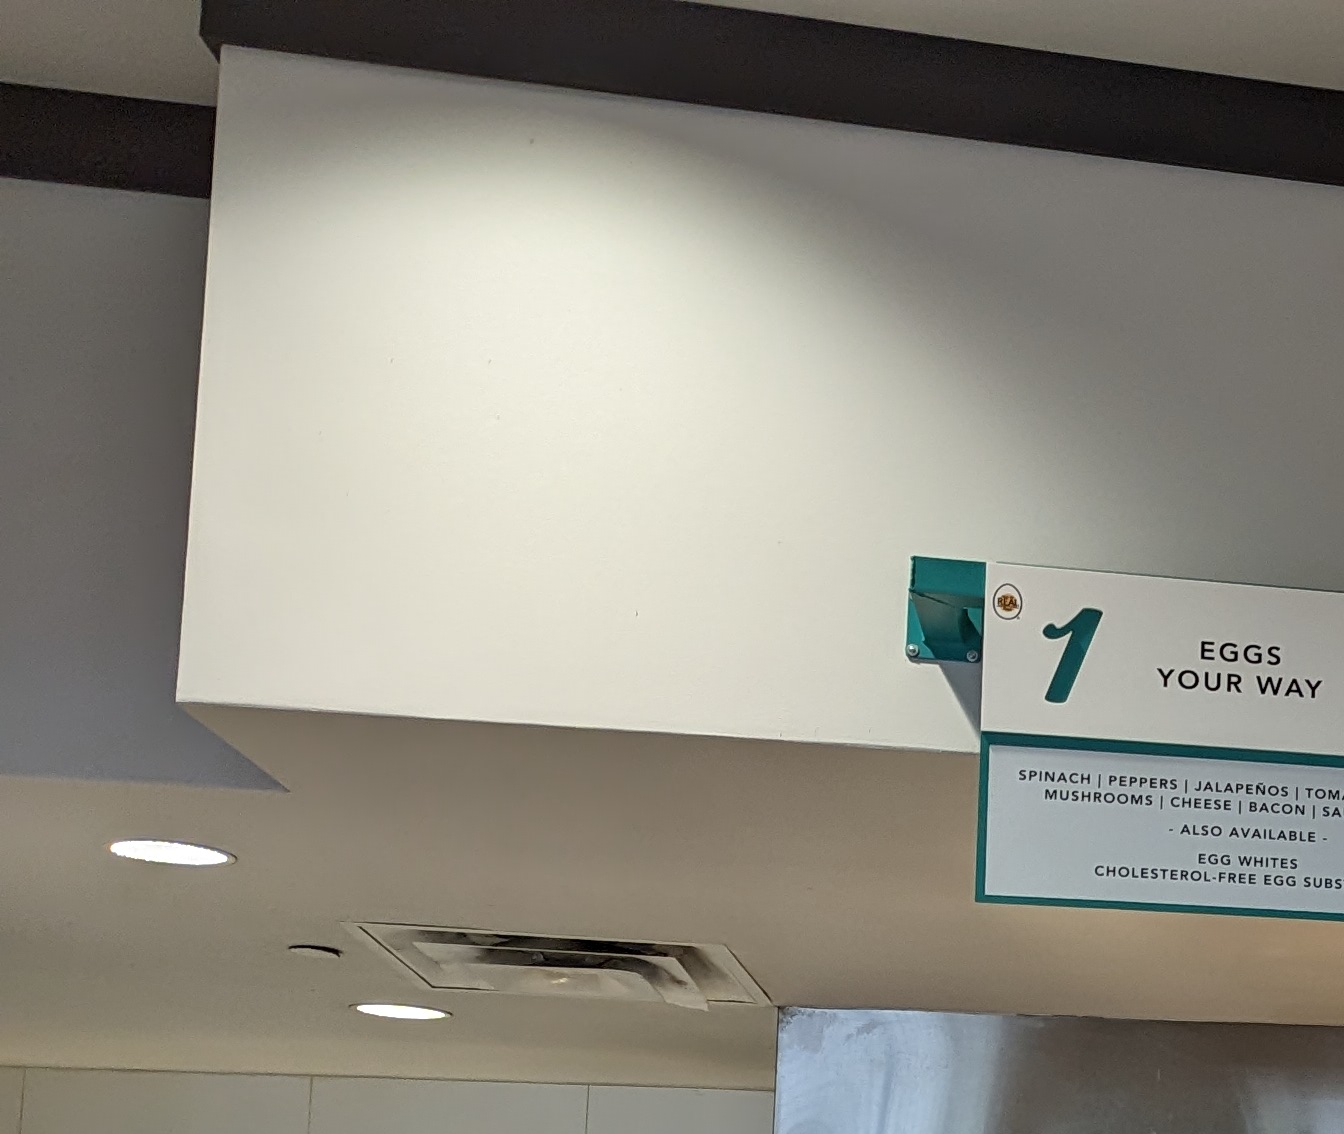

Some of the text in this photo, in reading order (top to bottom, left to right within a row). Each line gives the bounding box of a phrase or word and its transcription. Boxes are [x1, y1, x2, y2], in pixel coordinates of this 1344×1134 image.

[1042, 607, 1104, 704] 1
[1200, 640, 1282, 667] EGGS
[1156, 667, 1323, 700] YOUR WAY
[1018, 769, 1091, 786] SPINACH
[1108, 774, 1178, 791] PEPPERS
[1194, 779, 1289, 798] JALAPEÑOS
[1044, 788, 1153, 807] MUSHROOMS
[1170, 795, 1232, 812] CHEESE
[1248, 799, 1306, 817] BACON
[1179, 823, 1223, 838] ALSO
[1228, 826, 1316, 844] AVAILABLE
[1198, 852, 1298, 871] EGG WHITES
[1094, 864, 1257, 886] CHOLESTEROL-FREE
[1263, 873, 1297, 888] EGG
